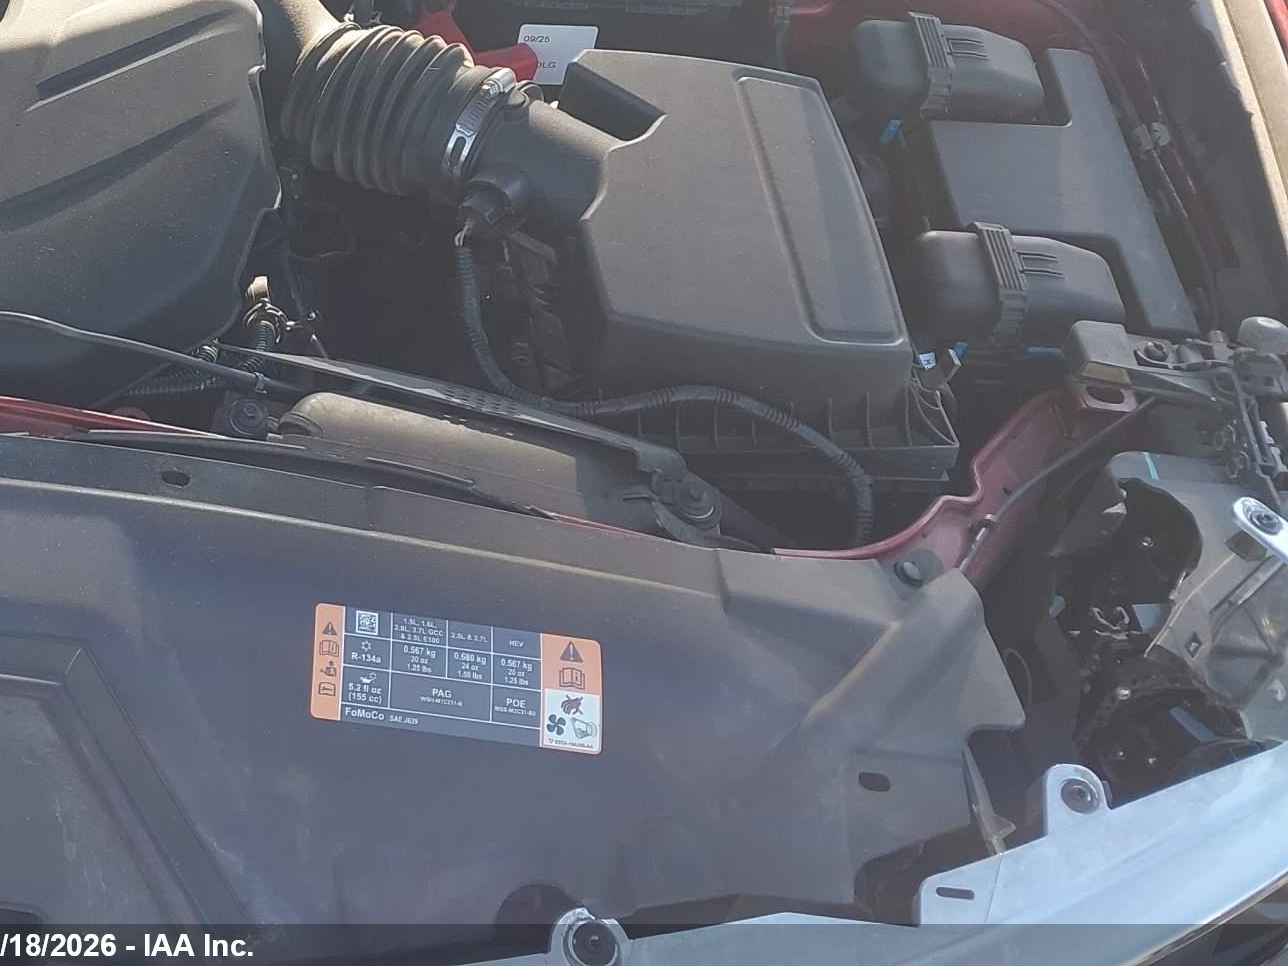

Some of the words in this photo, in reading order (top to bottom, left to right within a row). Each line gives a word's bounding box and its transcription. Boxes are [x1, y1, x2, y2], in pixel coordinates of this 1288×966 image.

[423, 636, 440, 644] E100
[403, 645, 424, 655] 0.567
[426, 648, 436, 658] kg
[351, 652, 382, 663] R-134a
[454, 652, 475, 662] 0.680
[476, 655, 487, 666] kg
[407, 664, 420, 672] 1.25
[501, 659, 520, 668] 0.567
[523, 661, 532, 672] kg
[472, 672, 483, 680] lbs
[505, 676, 518, 684] 1.25
[518, 678, 528, 686] lbs
[348, 683, 361, 692] 5.2
[363, 685, 369, 693] fl
[432, 688, 452, 698] PAG
[348, 692, 367, 701] (155
[369, 695, 382, 704] cc)
[506, 698, 527, 708] POE
[345, 707, 385, 720] FoMoCo
[389, 715, 403, 723] SAE
